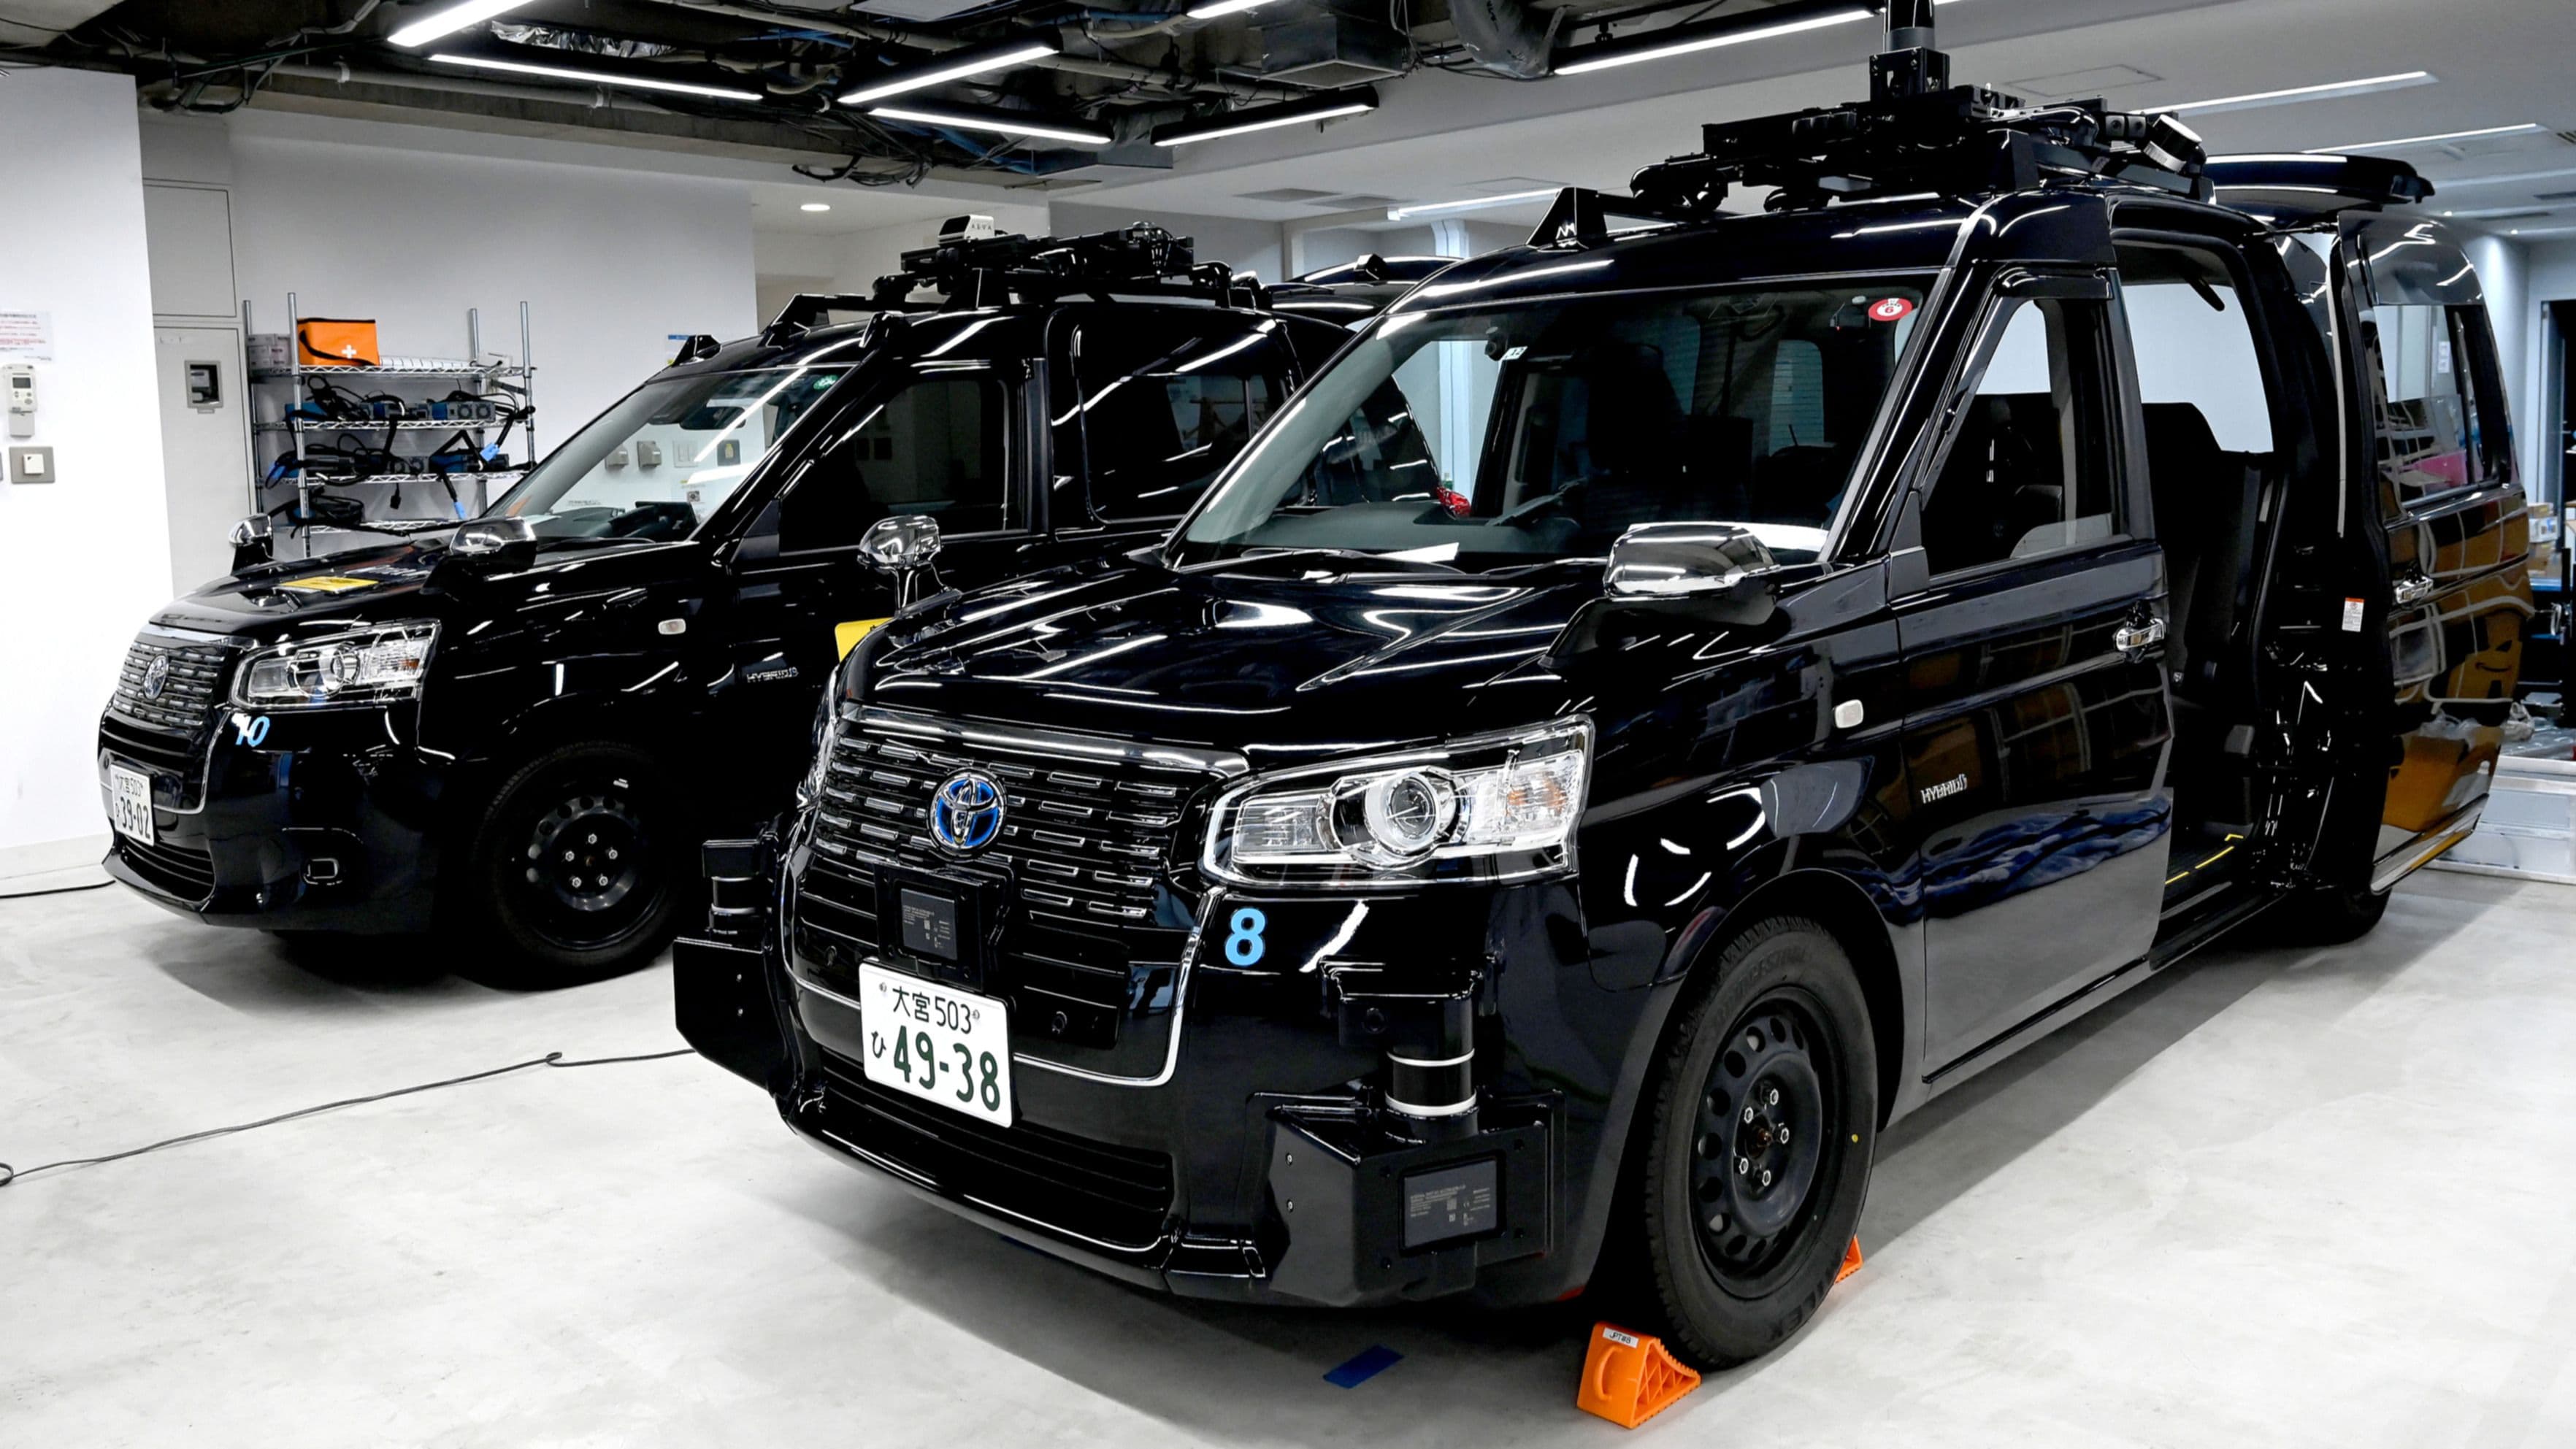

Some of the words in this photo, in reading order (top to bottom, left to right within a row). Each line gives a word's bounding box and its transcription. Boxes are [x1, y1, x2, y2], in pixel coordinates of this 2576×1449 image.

[232, 713, 270, 747] 10
[1920, 777, 1961, 804] HYBRID
[120, 796, 150, 839] 39-02
[1225, 907, 1265, 966] 8
[871, 1031, 886, 1058] ひ
[893, 1025, 1000, 1112] 49-38
